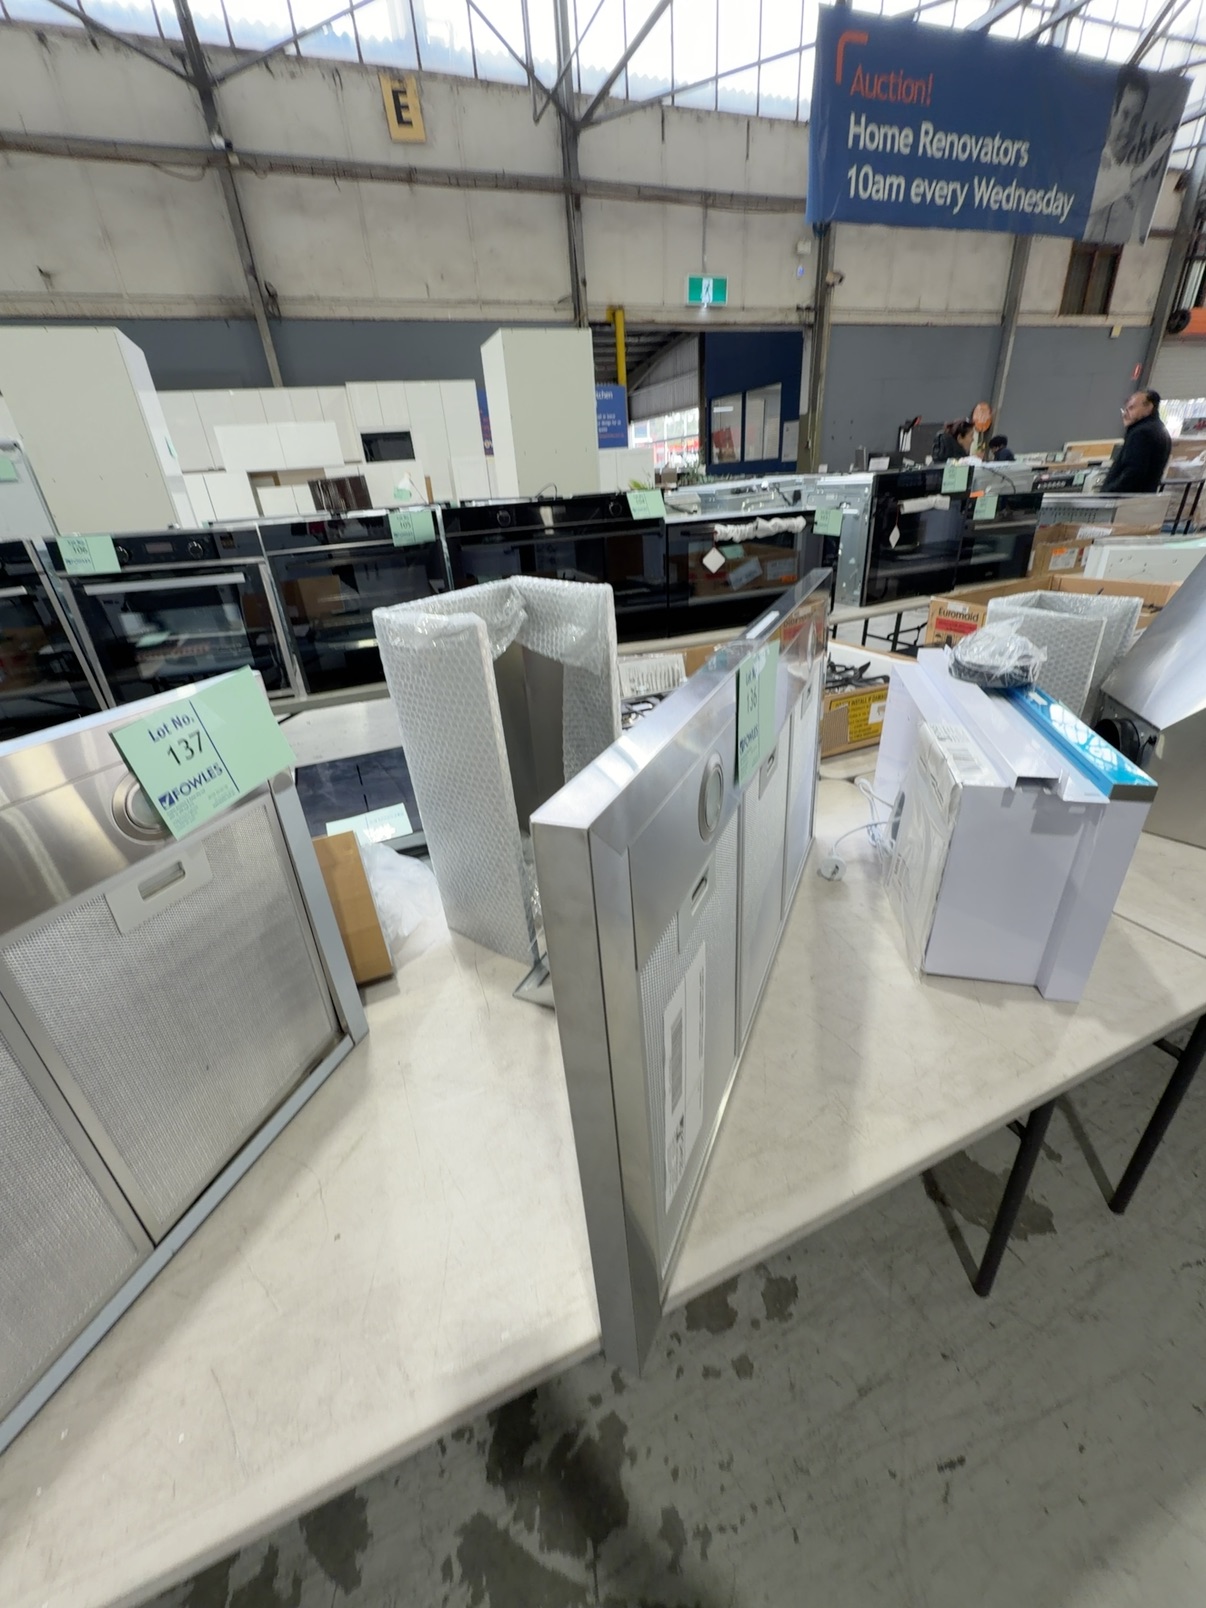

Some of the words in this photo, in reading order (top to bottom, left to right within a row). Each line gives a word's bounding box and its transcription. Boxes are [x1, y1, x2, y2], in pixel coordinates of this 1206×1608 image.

[850, 64, 933, 107] Auction!
[391, 88, 413, 127] E
[847, 111, 913, 155] Home
[917, 119, 1031, 168] Renovators
[847, 163, 905, 203] 10am
[910, 175, 970, 216] every
[973, 175, 1075, 225] Wednesday
[938, 606, 979, 622] Euromaid
[147, 722, 172, 743] Lot
[171, 714, 195, 731] No.
[167, 731, 203, 766] 137
[171, 762, 223, 802] FOWLES
